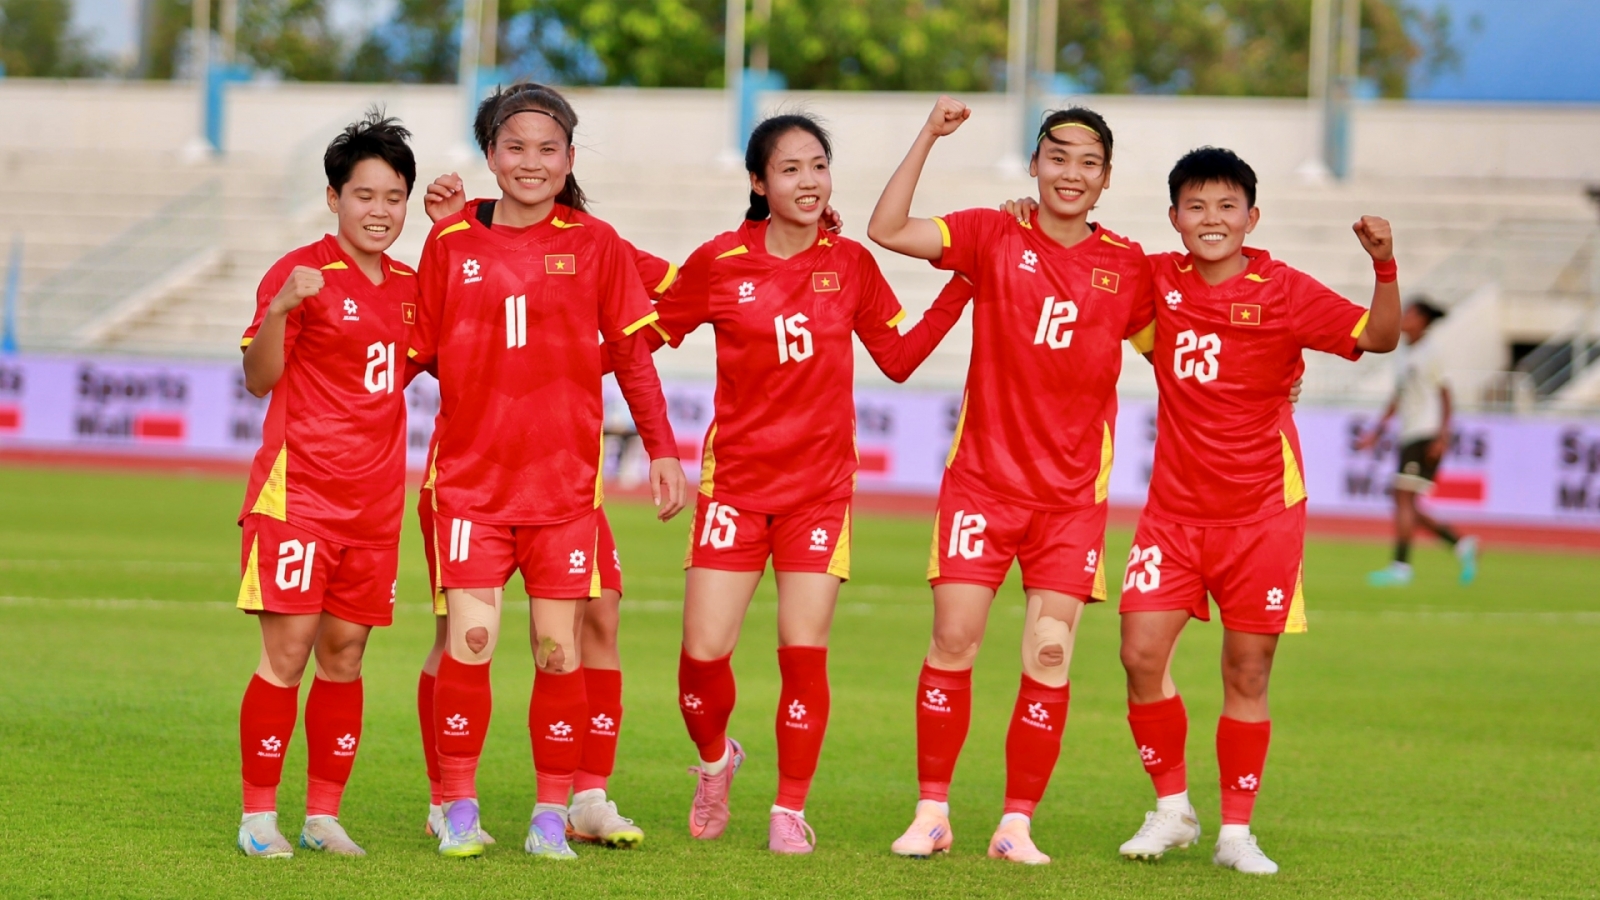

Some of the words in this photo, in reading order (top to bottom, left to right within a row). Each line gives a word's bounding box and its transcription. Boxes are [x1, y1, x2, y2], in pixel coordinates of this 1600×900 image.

[505, 294, 527, 349] 11
[774, 313, 814, 364] 15
[1034, 295, 1078, 350] 12
[364, 341, 395, 394] 21
[1174, 330, 1222, 384] 23
[449, 518, 473, 563] 11
[699, 502, 740, 550] 15
[948, 510, 988, 560] 12
[276, 539, 316, 593] 21
[1122, 544, 1163, 594] 23
